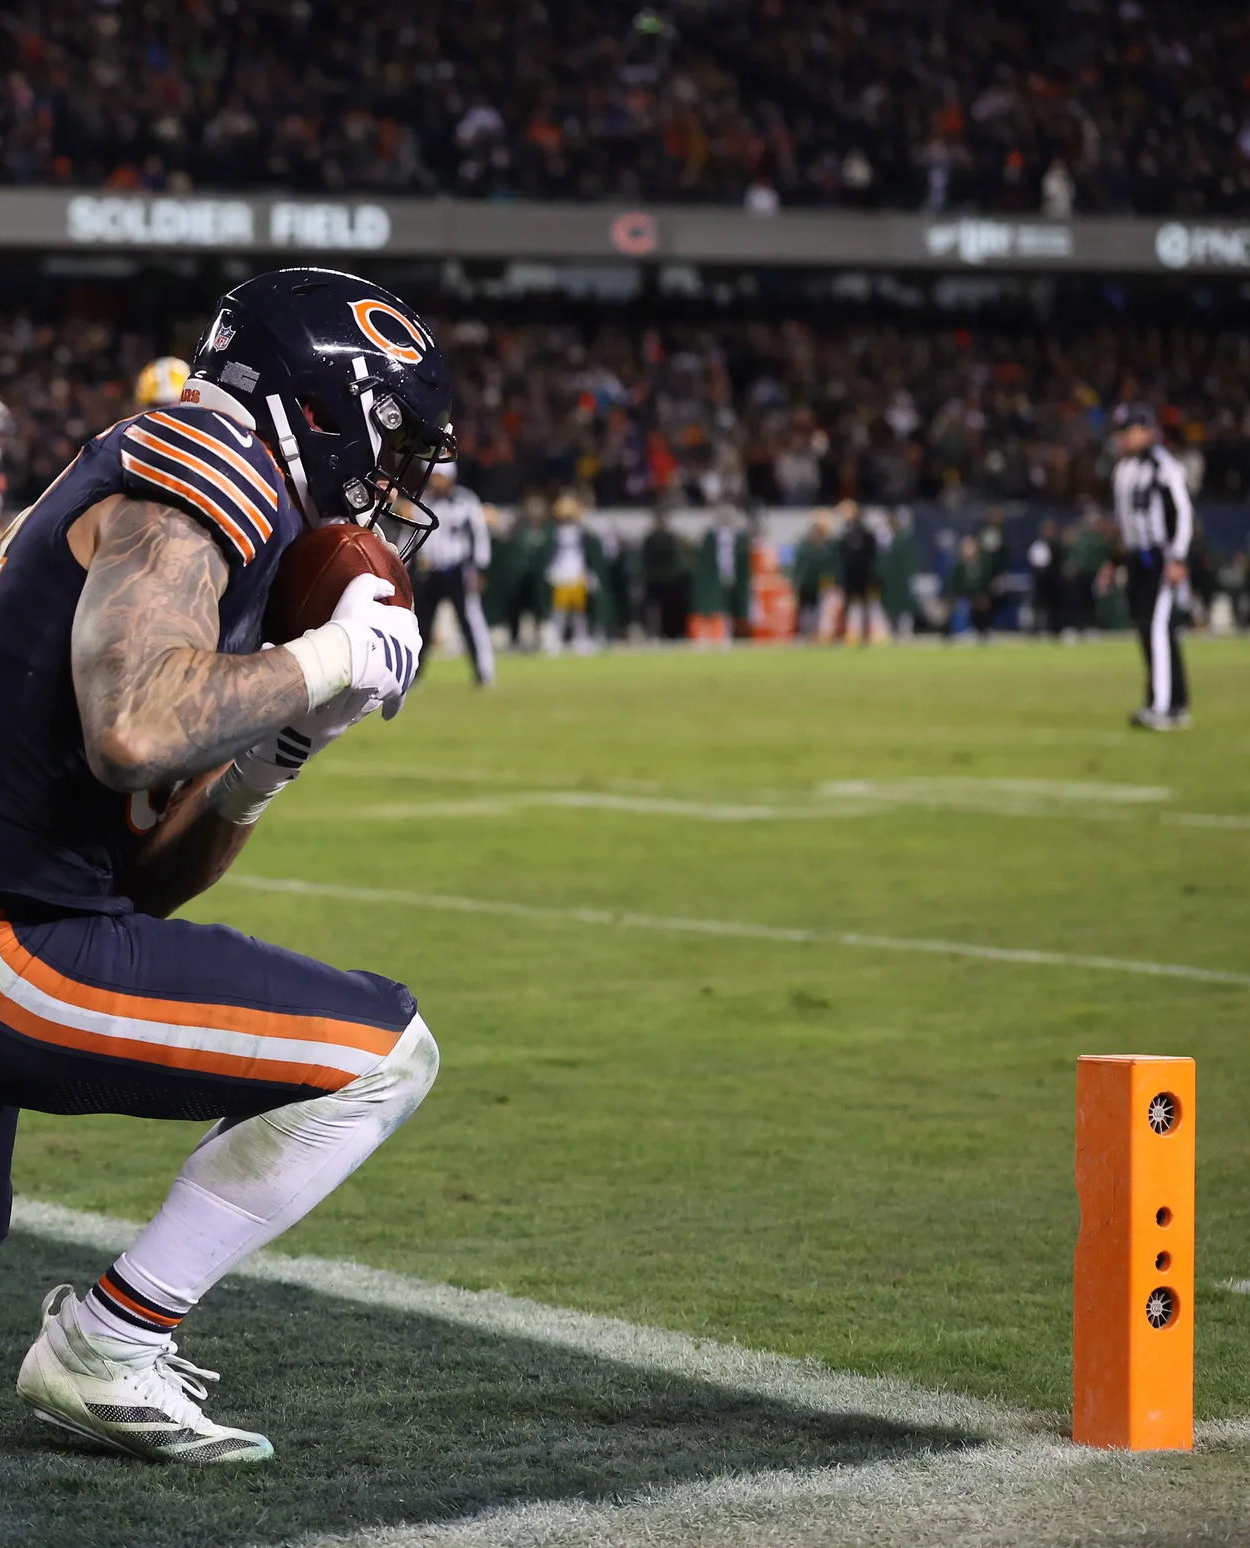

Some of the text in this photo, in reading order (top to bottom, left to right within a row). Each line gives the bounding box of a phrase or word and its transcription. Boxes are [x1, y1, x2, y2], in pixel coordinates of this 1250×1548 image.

[67, 196, 390, 250] SOLDIER FIELD
[347, 298, 427, 364] C
